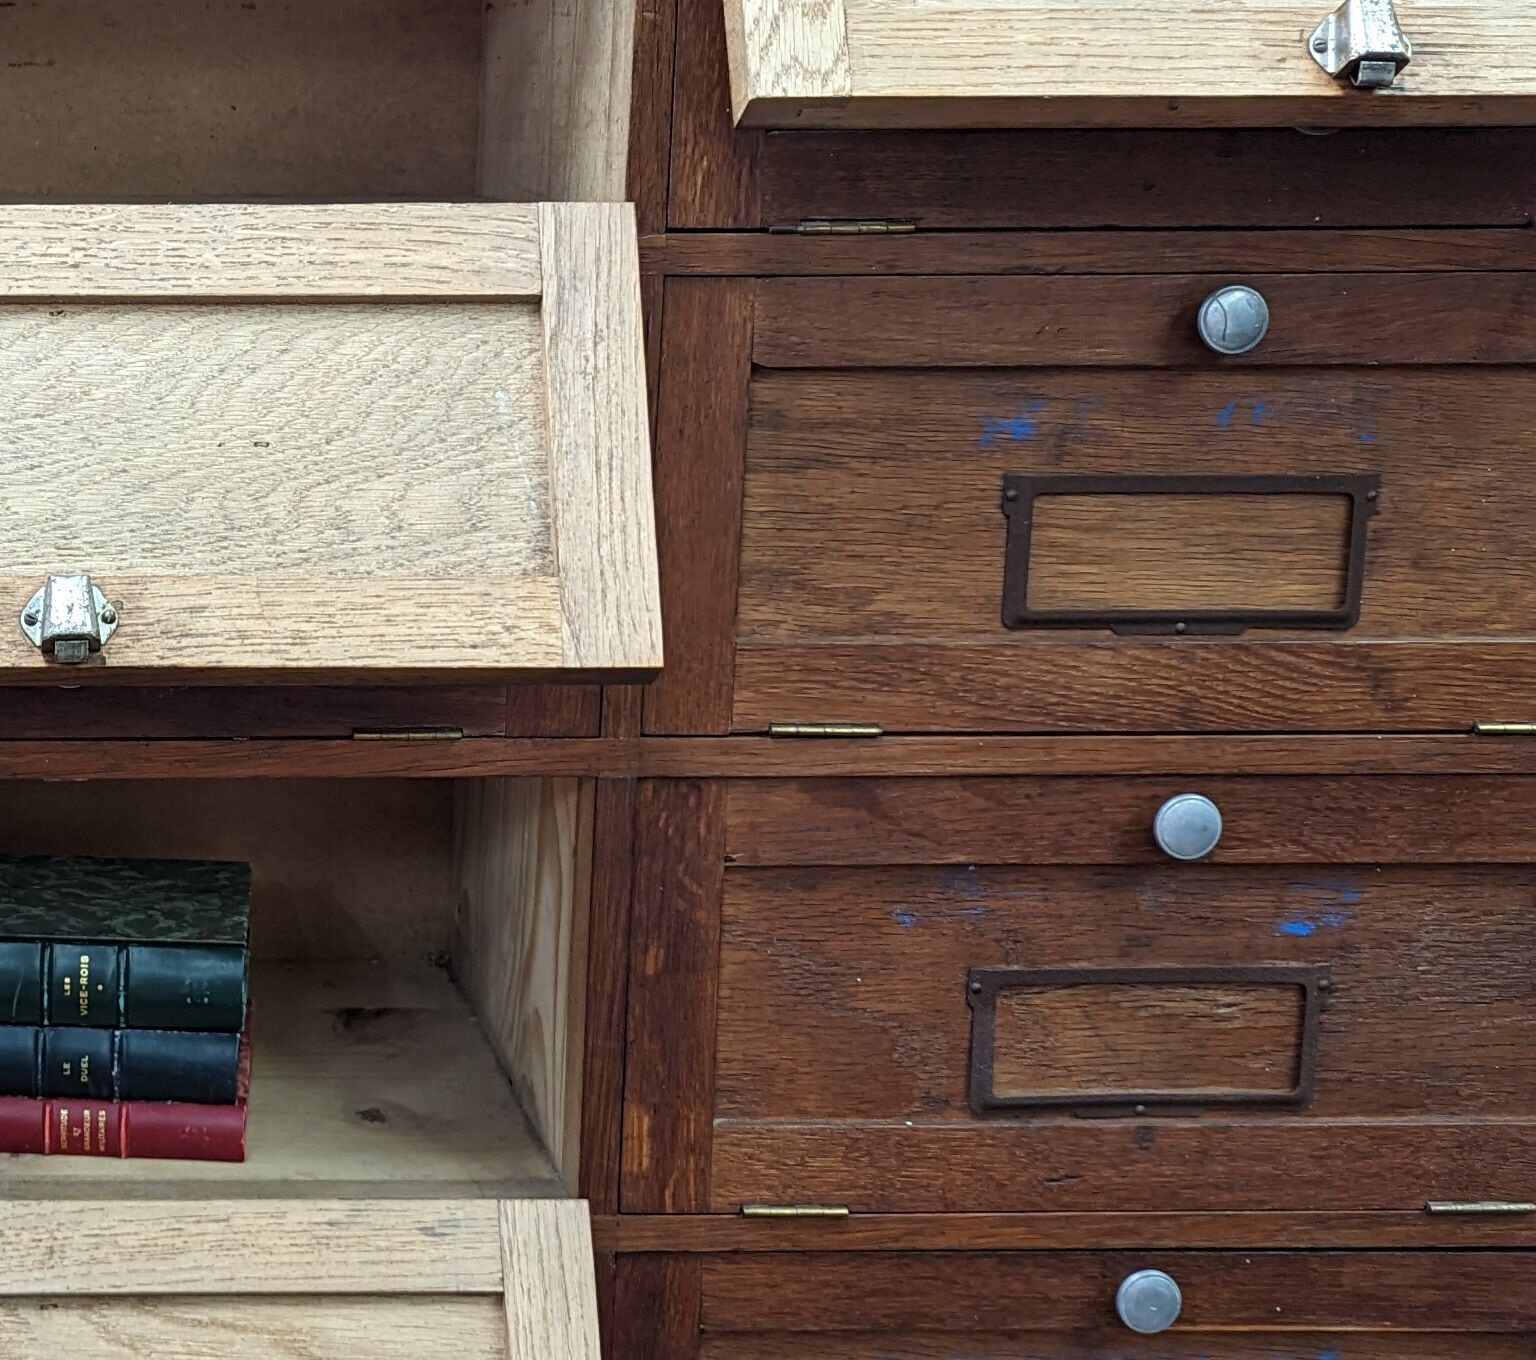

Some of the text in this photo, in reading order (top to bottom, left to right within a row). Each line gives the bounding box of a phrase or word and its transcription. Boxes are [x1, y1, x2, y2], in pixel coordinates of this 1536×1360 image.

[63, 976, 71, 996] LES
[79, 955, 90, 1016] VICE-ROIS
[62, 1061, 71, 1075] LE
[80, 1055, 89, 1083] DUEL
